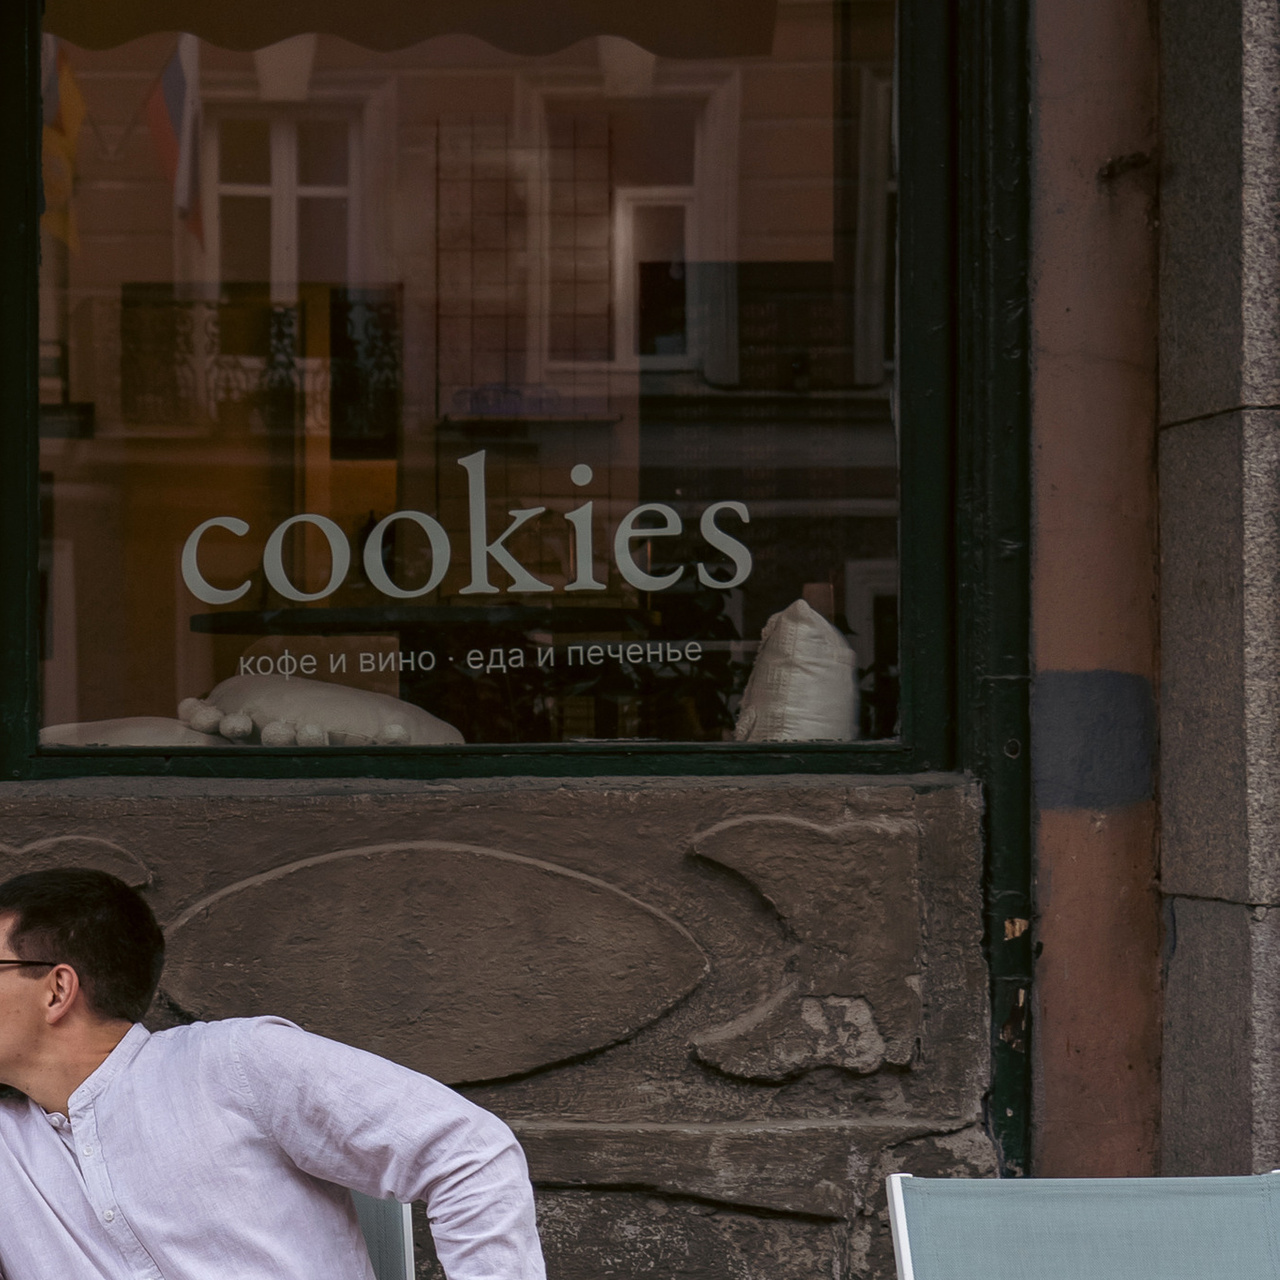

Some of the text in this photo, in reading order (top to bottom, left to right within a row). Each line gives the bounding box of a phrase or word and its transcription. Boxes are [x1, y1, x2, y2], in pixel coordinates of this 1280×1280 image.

[180, 449, 753, 605] cookies
[239, 640, 703, 681] кофе и вино еда и печенье
